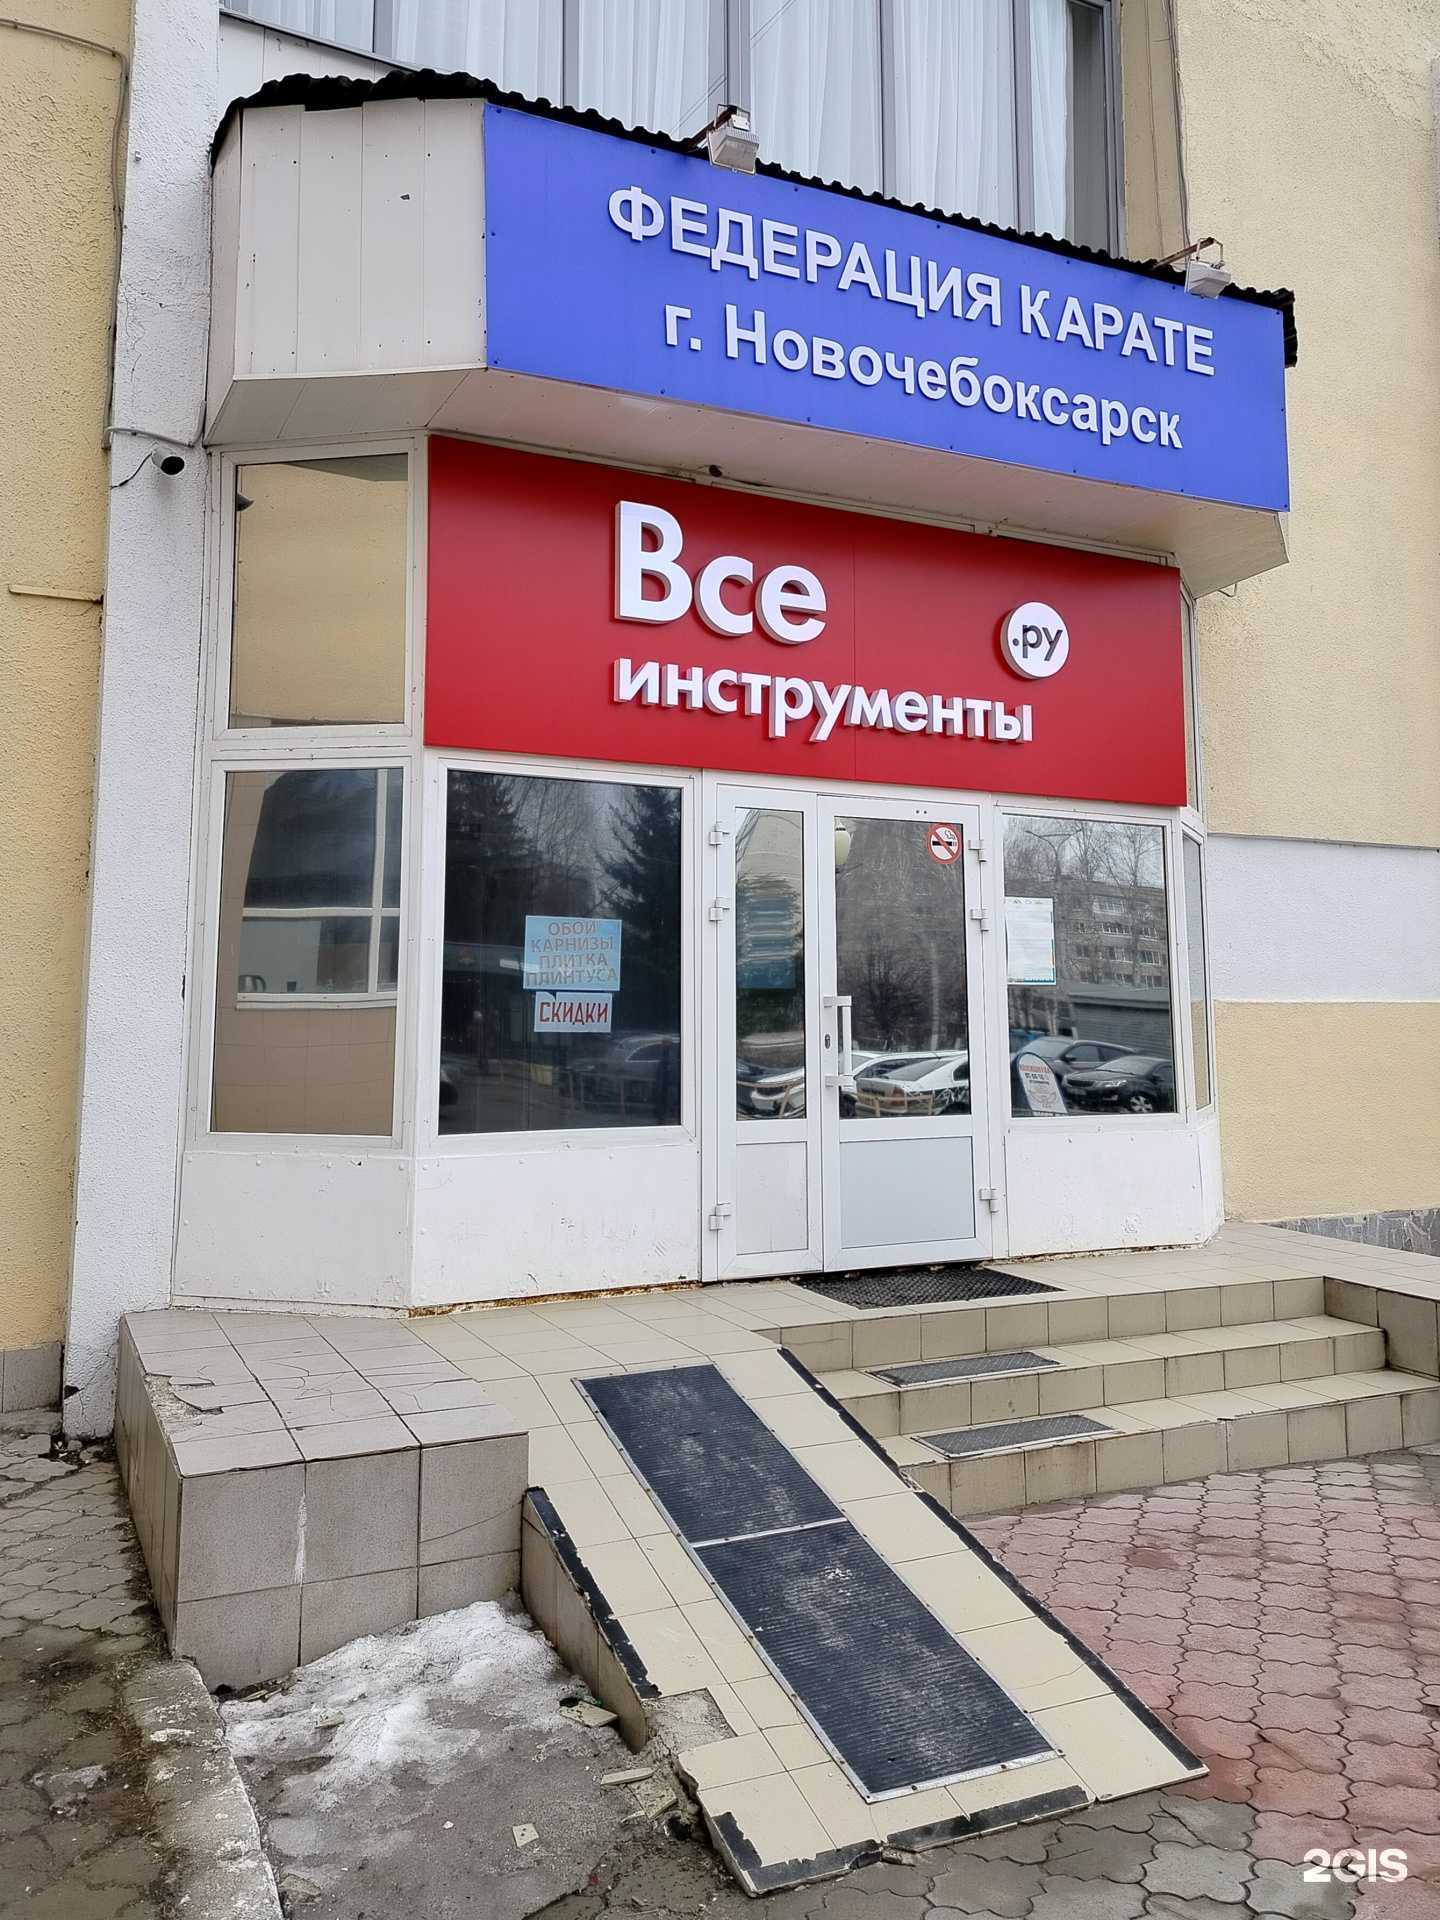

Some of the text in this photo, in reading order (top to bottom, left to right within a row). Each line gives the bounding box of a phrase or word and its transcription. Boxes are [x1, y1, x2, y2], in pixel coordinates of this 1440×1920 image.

[607, 185, 1216, 377] ФЕДЕРАЦИЯ КАРАТЕ
[664, 303, 1184, 450] г. Новочебоксарск
[614, 500, 828, 646] Все
[1011, 623, 1064, 662] .ру
[613, 657, 1034, 744] инструменты
[547, 920, 597, 936] ОБОИ
[531, 935, 614, 953] КАРНИЗЫ
[538, 952, 609, 969] ПЛИТКА
[525, 967, 618, 987] ПЛИНТУСА
[539, 1001, 609, 1025] СКИДКИ
